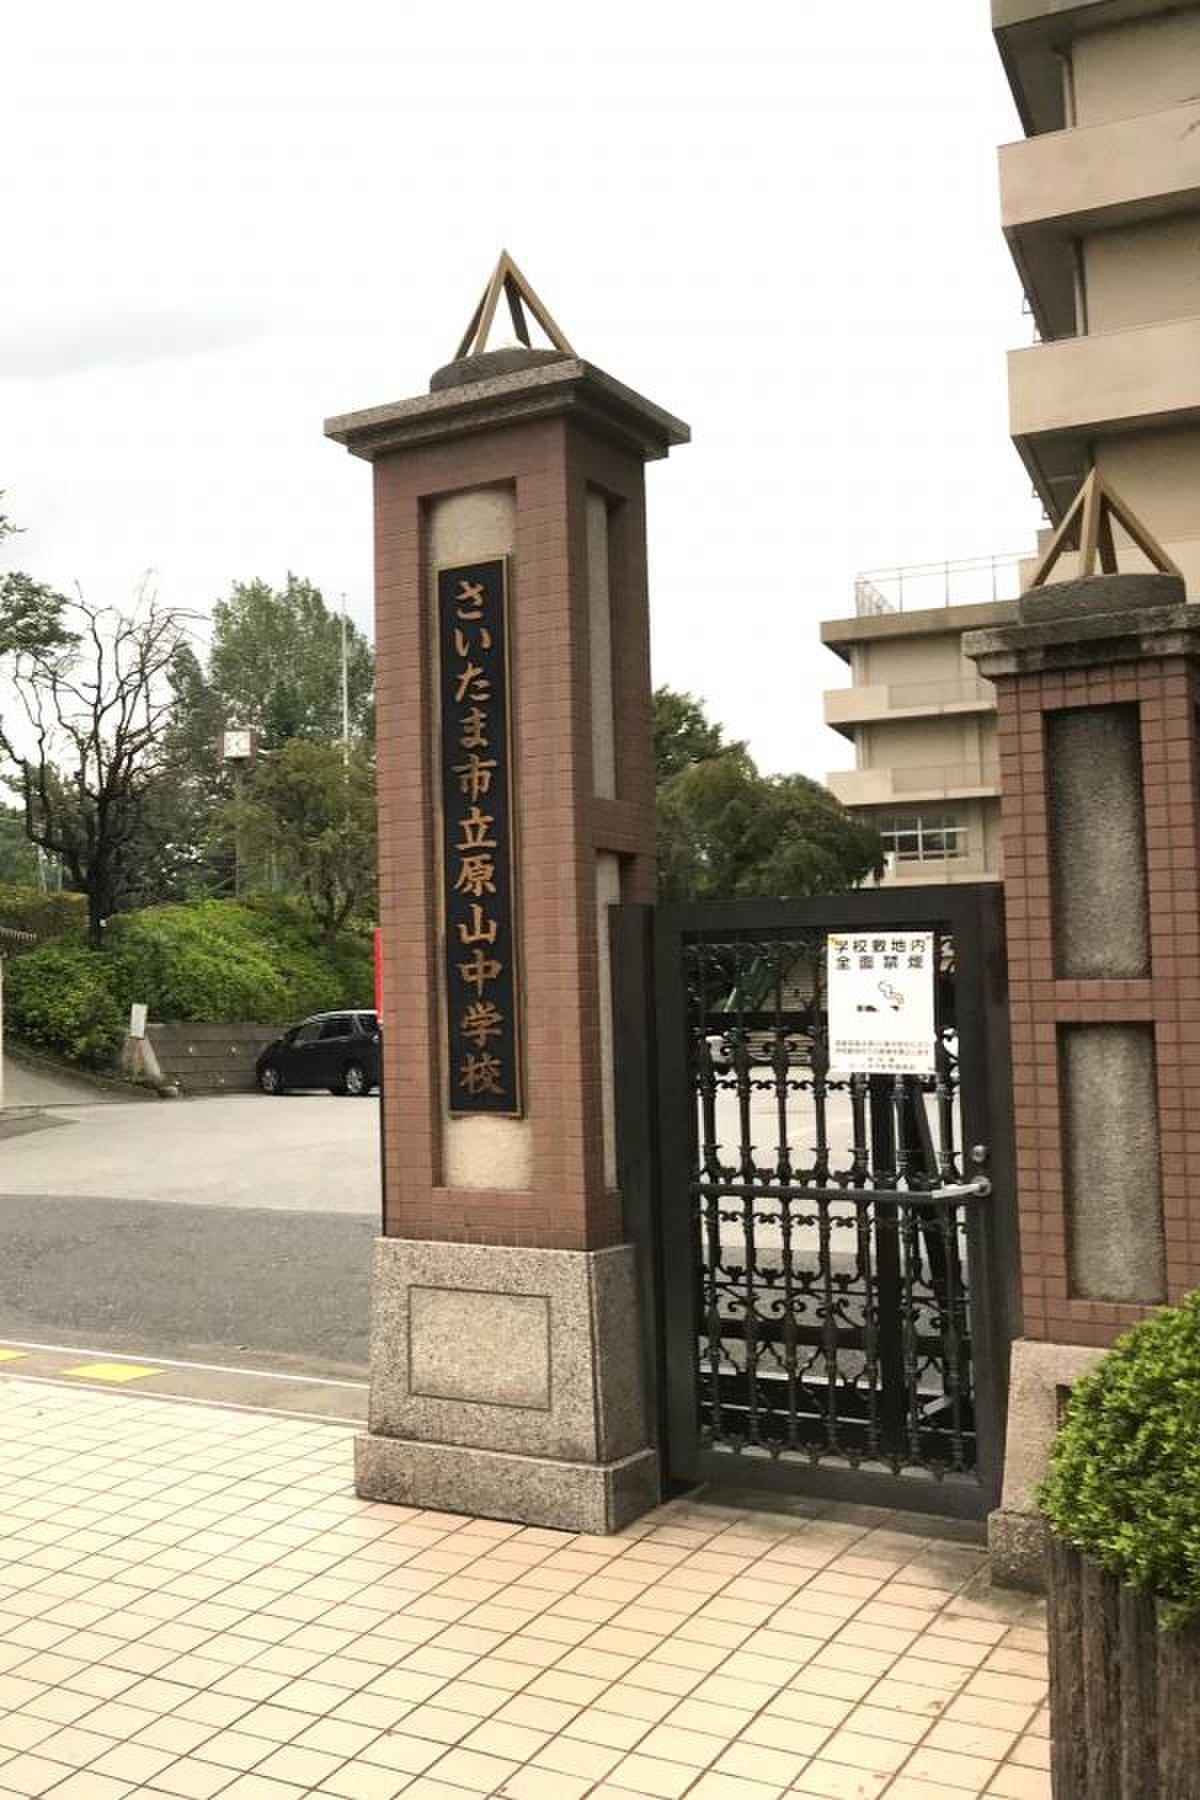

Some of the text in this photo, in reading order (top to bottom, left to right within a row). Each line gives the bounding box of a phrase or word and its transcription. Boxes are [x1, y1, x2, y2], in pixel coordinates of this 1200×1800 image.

[452, 579, 505, 1096] さいたま市立原山中学校
[834, 938, 926, 953] 学校敷地内
[835, 955, 924, 970] 全面禁煙
